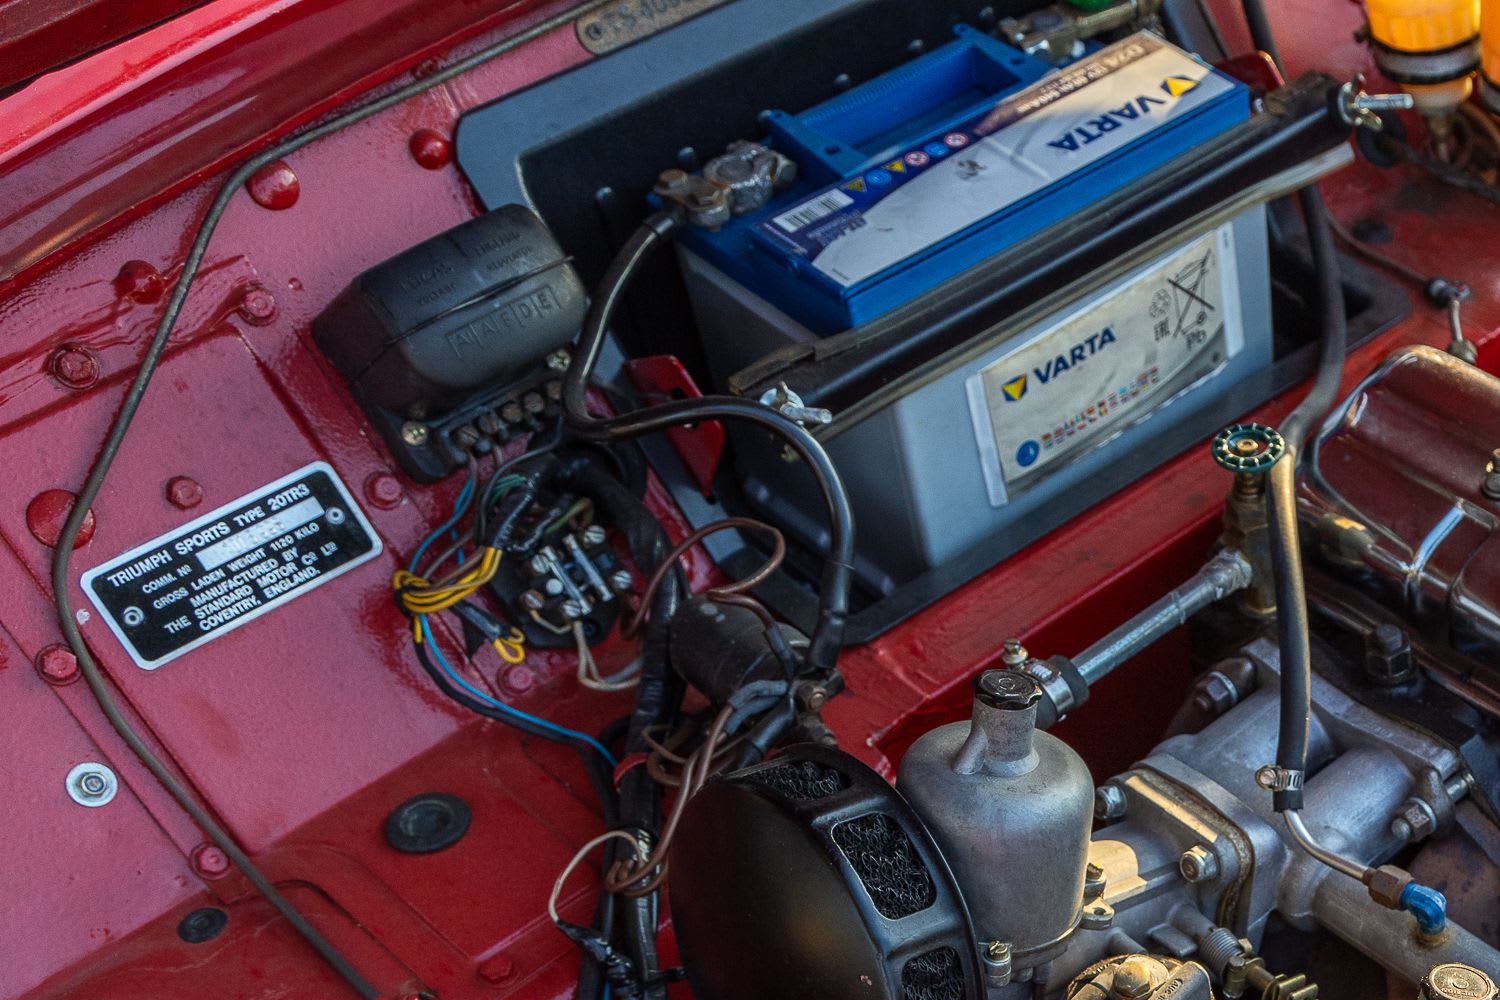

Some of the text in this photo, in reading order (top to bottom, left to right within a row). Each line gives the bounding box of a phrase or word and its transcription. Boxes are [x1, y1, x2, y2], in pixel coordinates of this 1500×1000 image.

[1047, 95, 1167, 151] VARTA
[1033, 326, 1117, 384] VARTA
[108, 550, 171, 588] TRIUMPH
[175, 522, 230, 555] SPORTS
[233, 507, 264, 528] TYPE
[268, 483, 309, 510] 20TR3
[153, 588, 188, 609] GROSS
[191, 569, 225, 590] LADEN
[228, 549, 266, 573] WEIGHT
[270, 536, 293, 552] 1120
[295, 524, 319, 540] KILO
[142, 573, 176, 594] COMM.
[164, 616, 190, 634] THE
[194, 585, 253, 619] STANDARD
[257, 563, 297, 588] MOTOR
[190, 548, 298, 607] MANUFACTURED BY
[199, 566, 320, 631] COVENTRY, ENGLAND.
